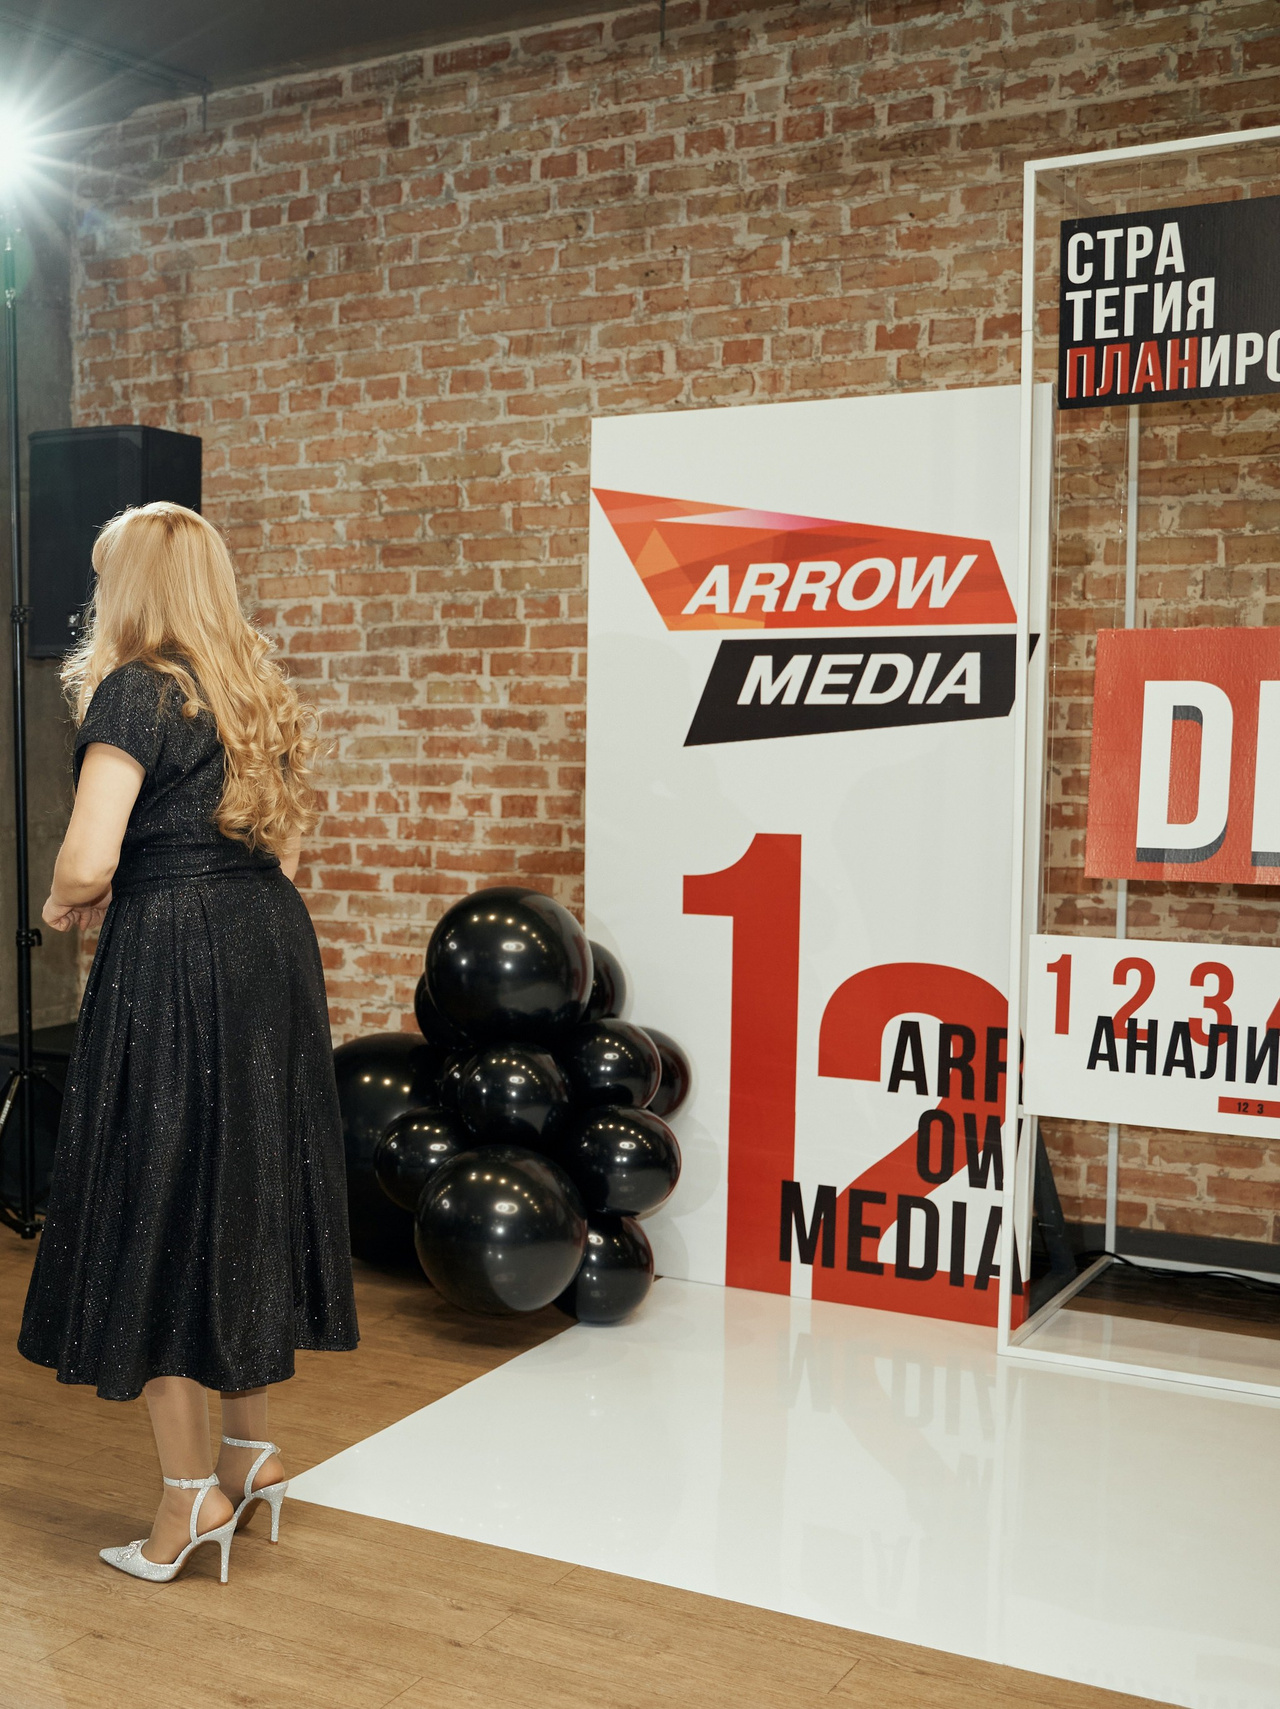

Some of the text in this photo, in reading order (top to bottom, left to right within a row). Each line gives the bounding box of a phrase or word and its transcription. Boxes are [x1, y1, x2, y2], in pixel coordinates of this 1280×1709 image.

[1067, 222, 1185, 284] СТРА
[1065, 277, 1215, 341] ТЕГИЯ
[681, 554, 978, 615] ARROW
[737, 652, 981, 706] MEDIA
[1047, 953, 1072, 1035] 1
[1112, 957, 1156, 1041] 2
[1188, 961, 1234, 1047] 3
[683, 832, 1028, 1330] 12
[1086, 1015, 1278, 1086] АНАЛИ
[779, 1180, 1024, 1295] MEDIA
